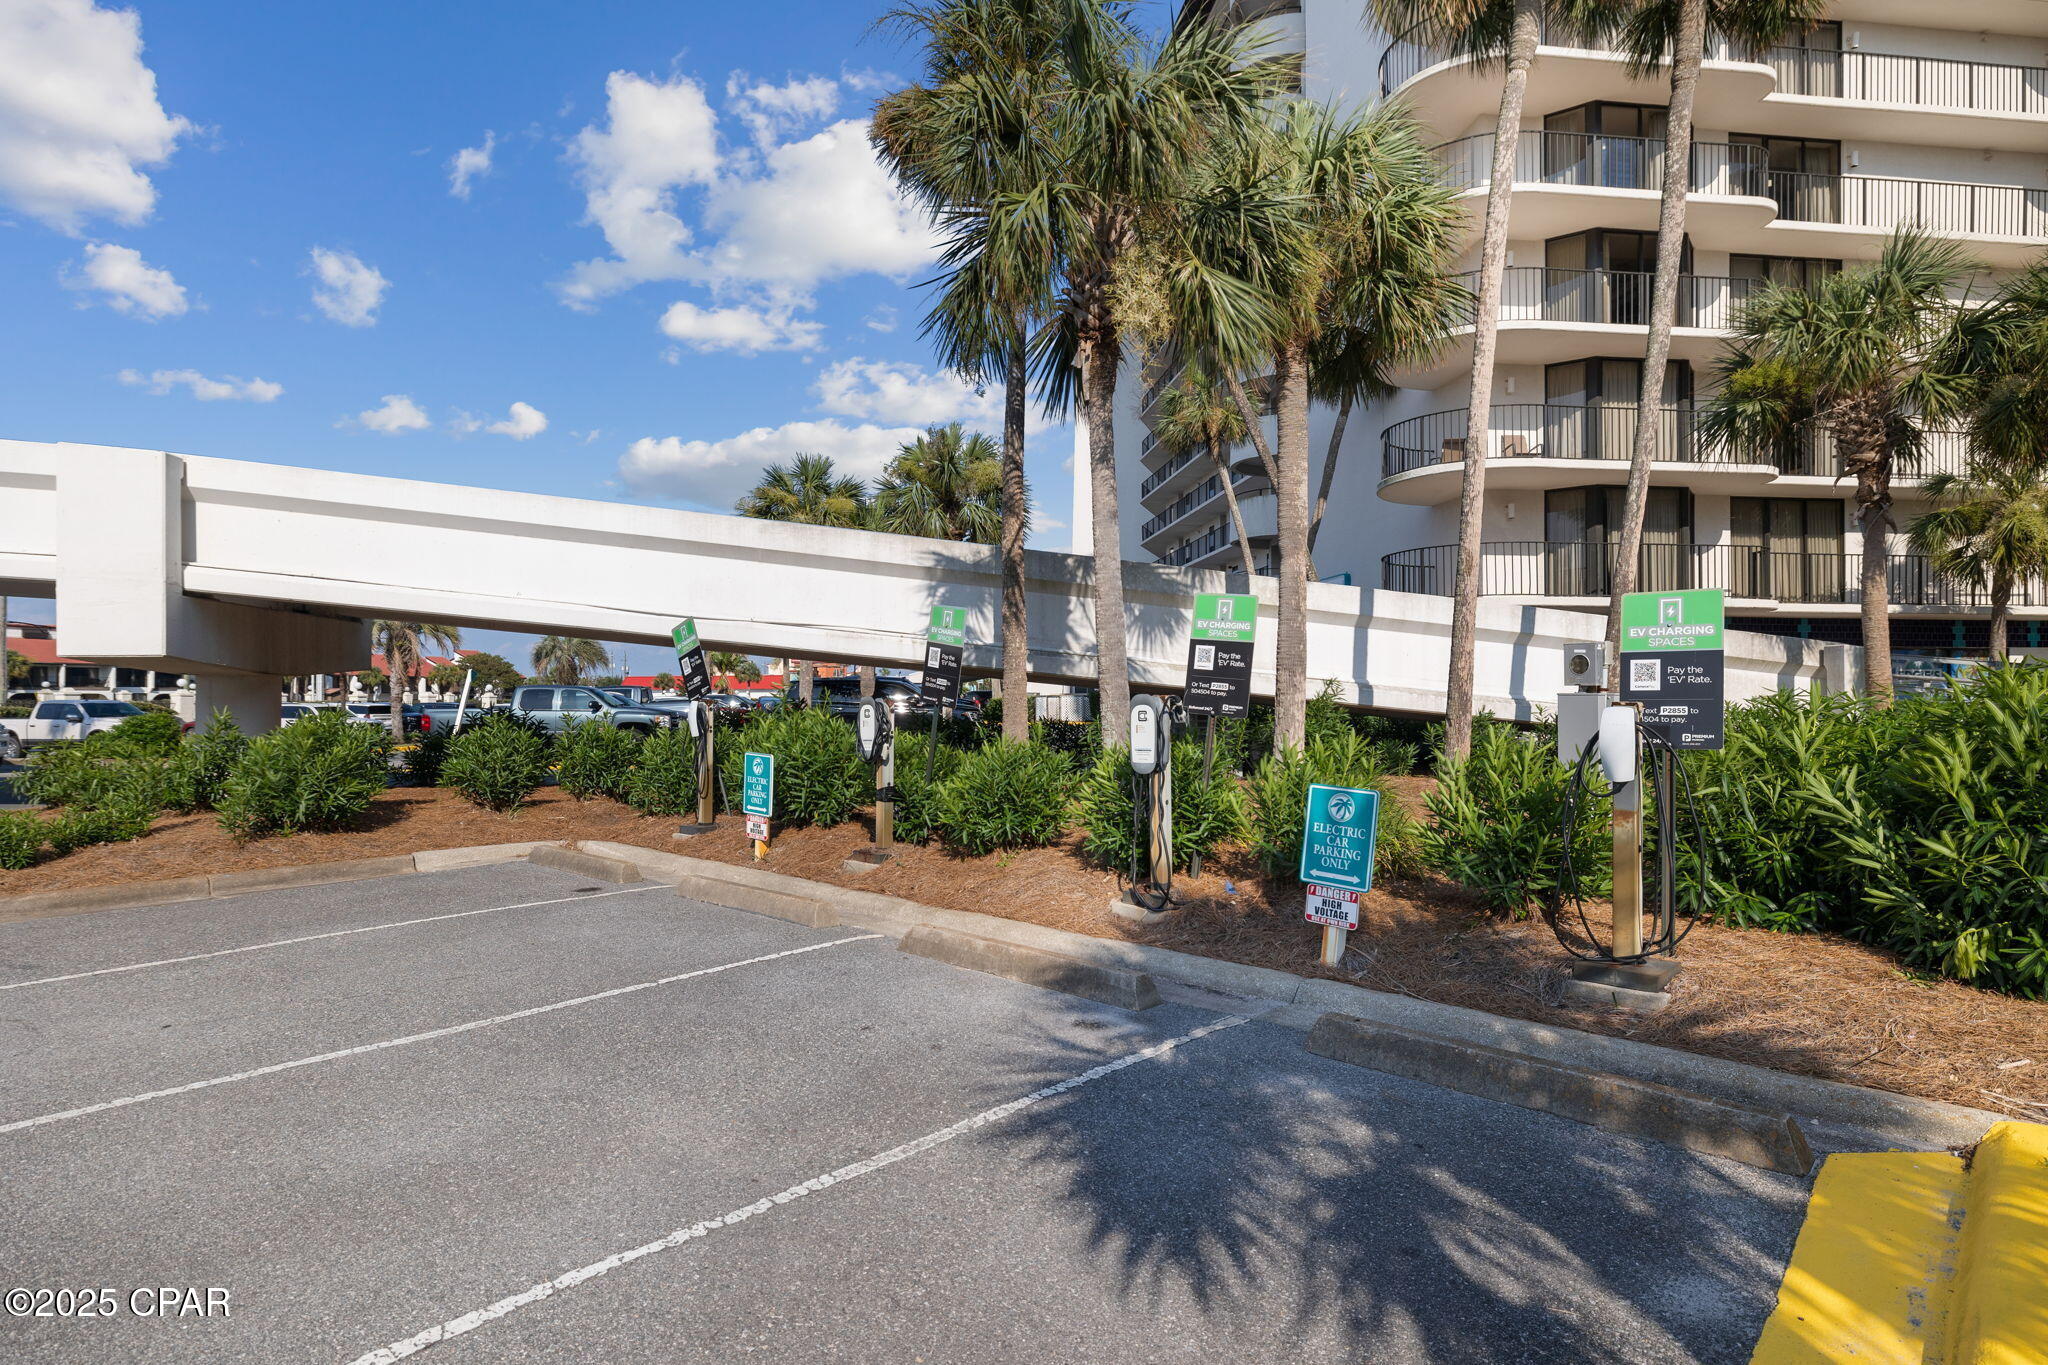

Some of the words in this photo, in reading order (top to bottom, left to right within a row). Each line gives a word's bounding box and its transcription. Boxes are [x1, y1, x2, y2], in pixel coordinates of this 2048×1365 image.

[1209, 621, 1250, 630] CHARGING
[938, 628, 962, 636] CHARGING
[1630, 629, 1645, 637] EV
[1649, 626, 1714, 636] CHARGING
[1648, 637, 1694, 647] SPACES
[1218, 652, 1230, 660] Pay
[1668, 666, 1685, 676] Pay
[1688, 666, 1704, 674] the
[1688, 675, 1712, 683] Rate.
[747, 776, 768, 785] ELECTRIC
[748, 790, 767, 798] PARKING
[1313, 822, 1366, 839] ELECTRIC
[1326, 835, 1348, 848] CAR
[1313, 844, 1361, 861] PARKING
[1322, 857, 1351, 870] ONLY
[1316, 886, 1351, 901] DANGER
[1322, 898, 1342, 910] HIGH
[1314, 906, 1349, 920] VOLTAGE
